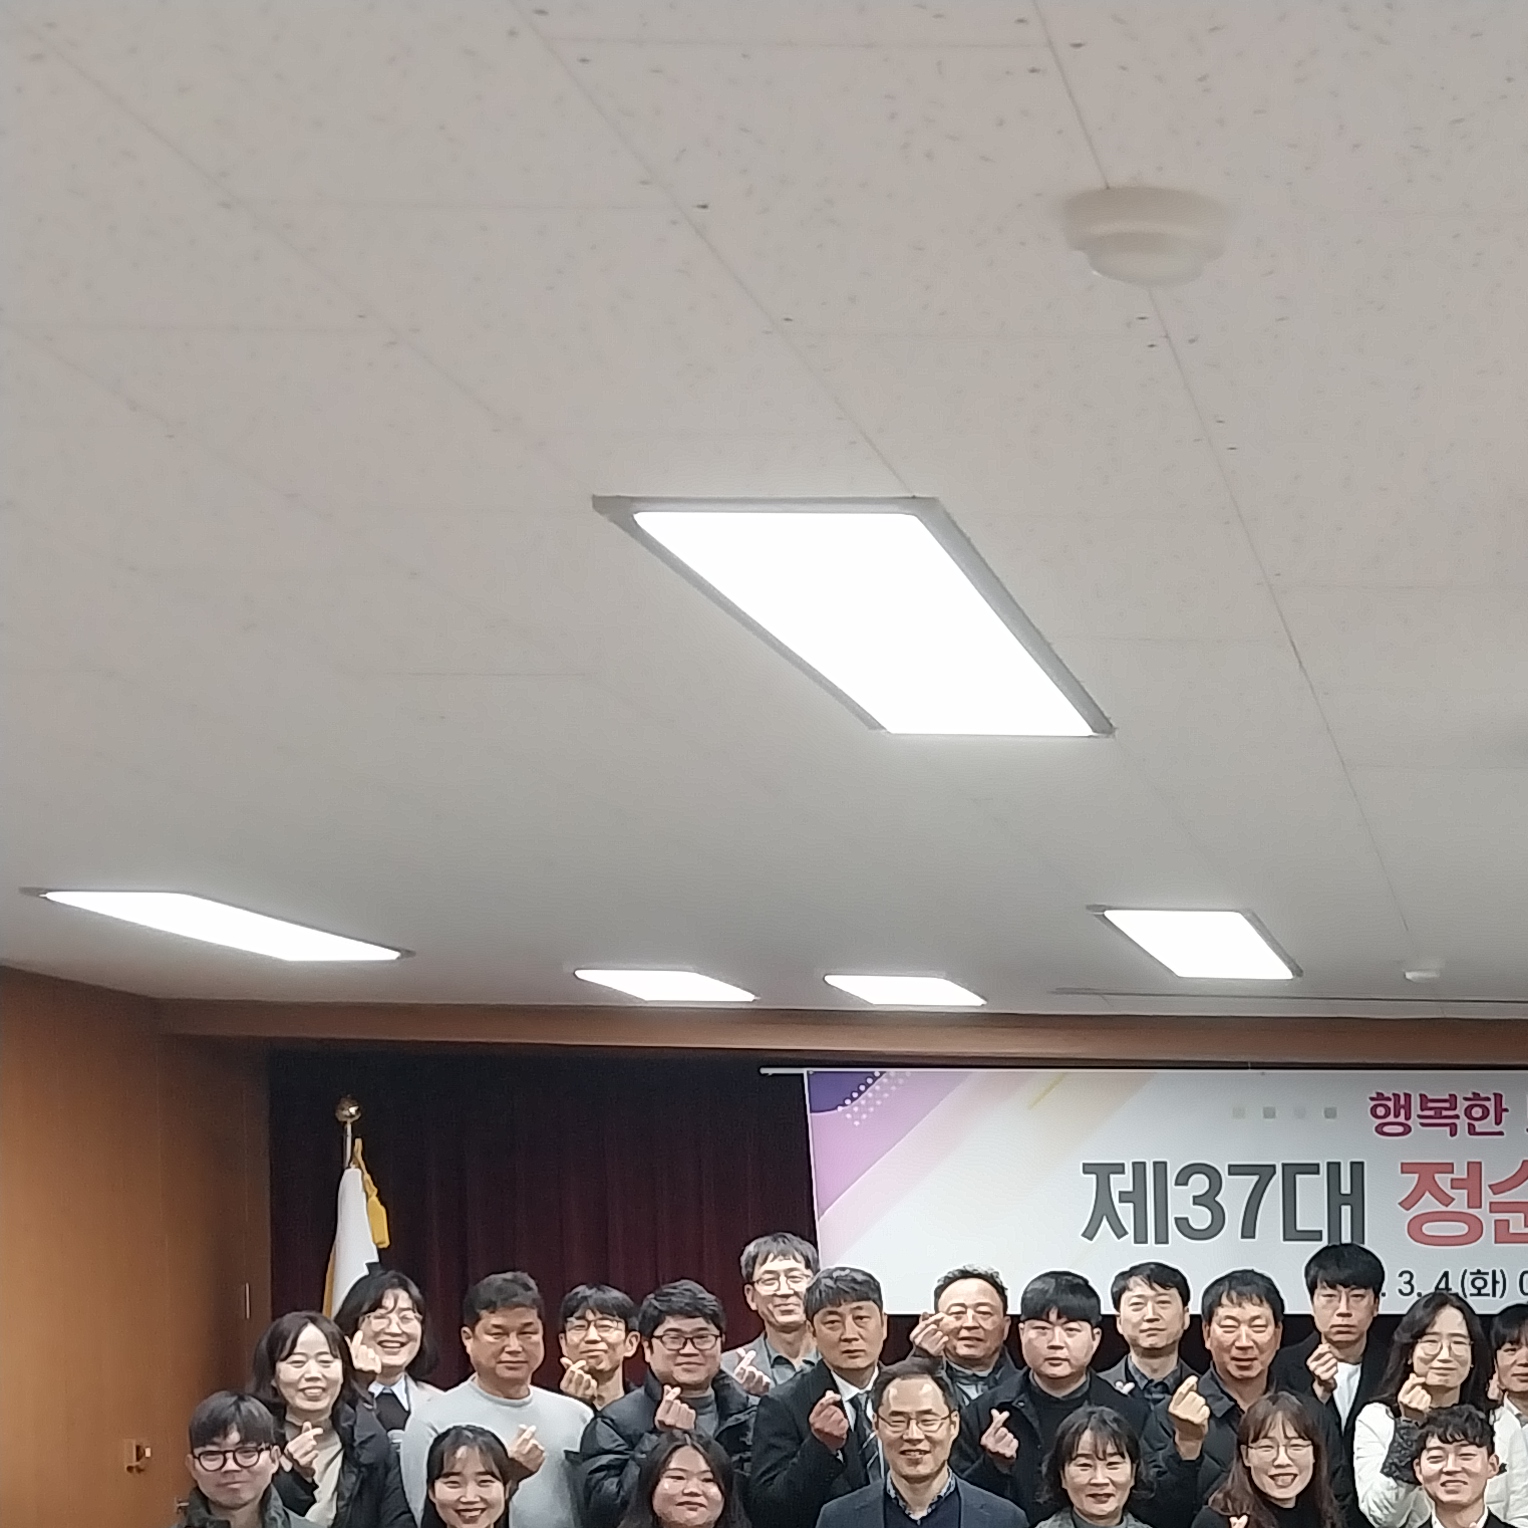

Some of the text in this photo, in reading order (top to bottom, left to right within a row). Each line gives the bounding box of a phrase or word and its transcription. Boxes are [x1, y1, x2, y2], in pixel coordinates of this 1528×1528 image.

[1368, 1090, 1510, 1138] 행복한
[1081, 1160, 1366, 1245] 제37대
[1397, 1269, 1423, 1298] 3.
